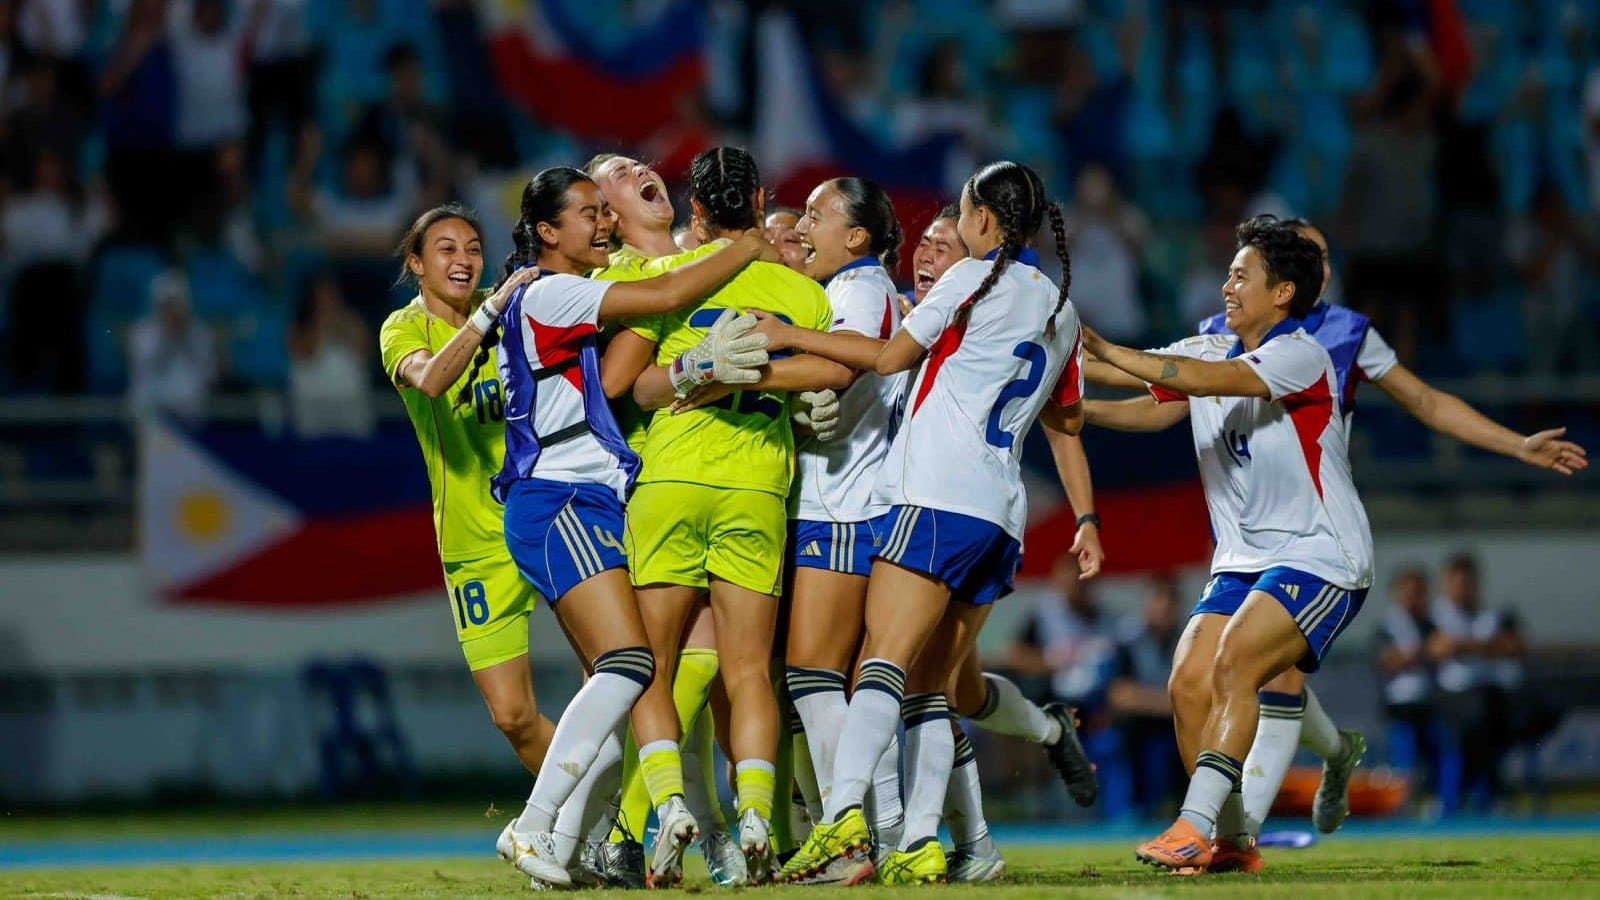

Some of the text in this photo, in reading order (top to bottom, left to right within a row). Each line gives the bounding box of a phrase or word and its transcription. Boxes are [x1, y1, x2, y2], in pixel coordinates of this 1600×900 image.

[474, 378, 504, 424] 18
[985, 341, 1046, 450] 2
[1221, 429, 1252, 468] 14
[593, 525, 627, 555] 4
[455, 581, 489, 629] 18
